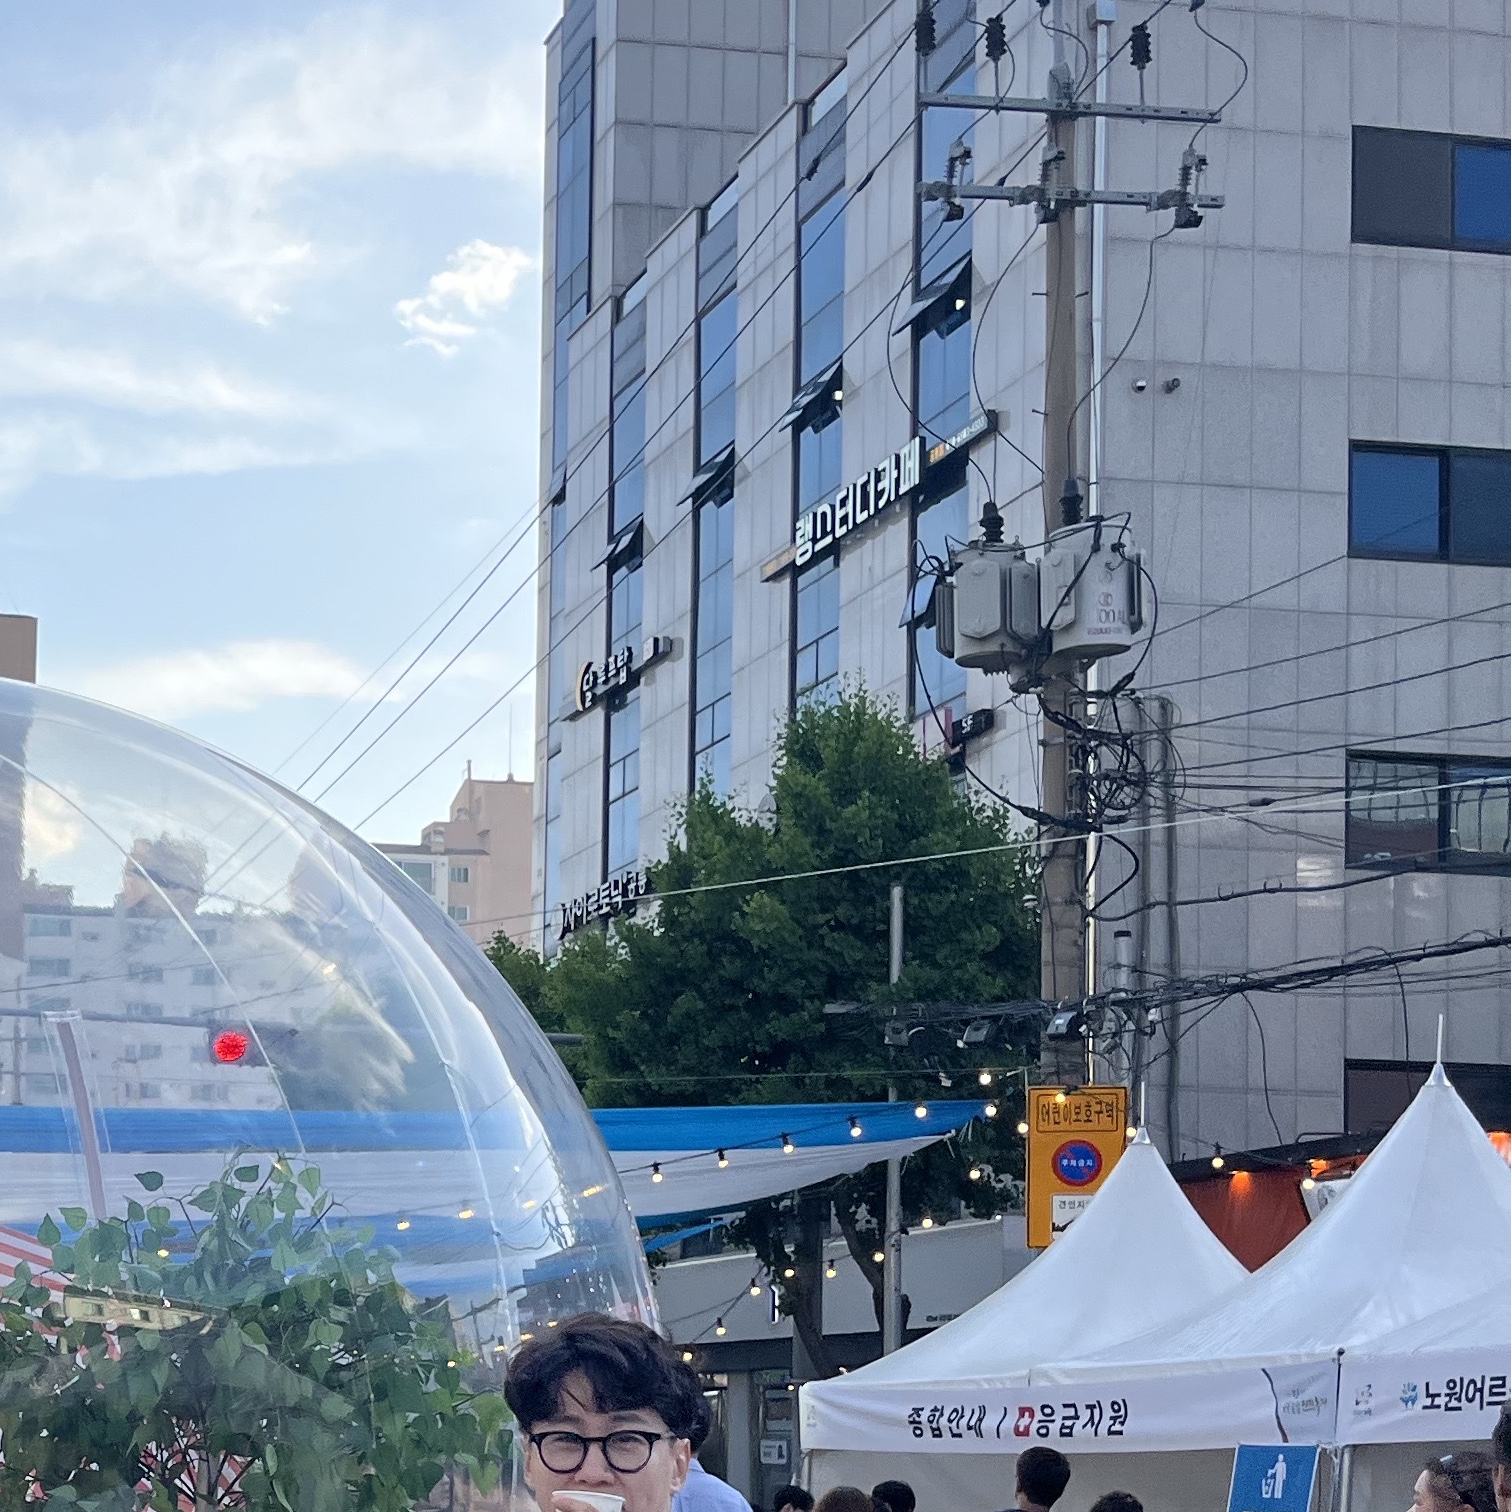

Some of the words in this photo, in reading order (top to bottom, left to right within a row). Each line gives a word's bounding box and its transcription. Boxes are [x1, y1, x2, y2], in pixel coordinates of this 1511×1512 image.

[795, 436, 921, 566] 랭스터디카페
[1040, 1100, 1115, 1126] 어린이보호구역
[1061, 1158, 1094, 1167] 주차금지
[1058, 1200, 1088, 1210] 견인지
[1422, 1374, 1511, 1412] 노원어르
[908, 1404, 986, 1439] 종합안내
[1036, 1398, 1129, 1438] 응급지원
